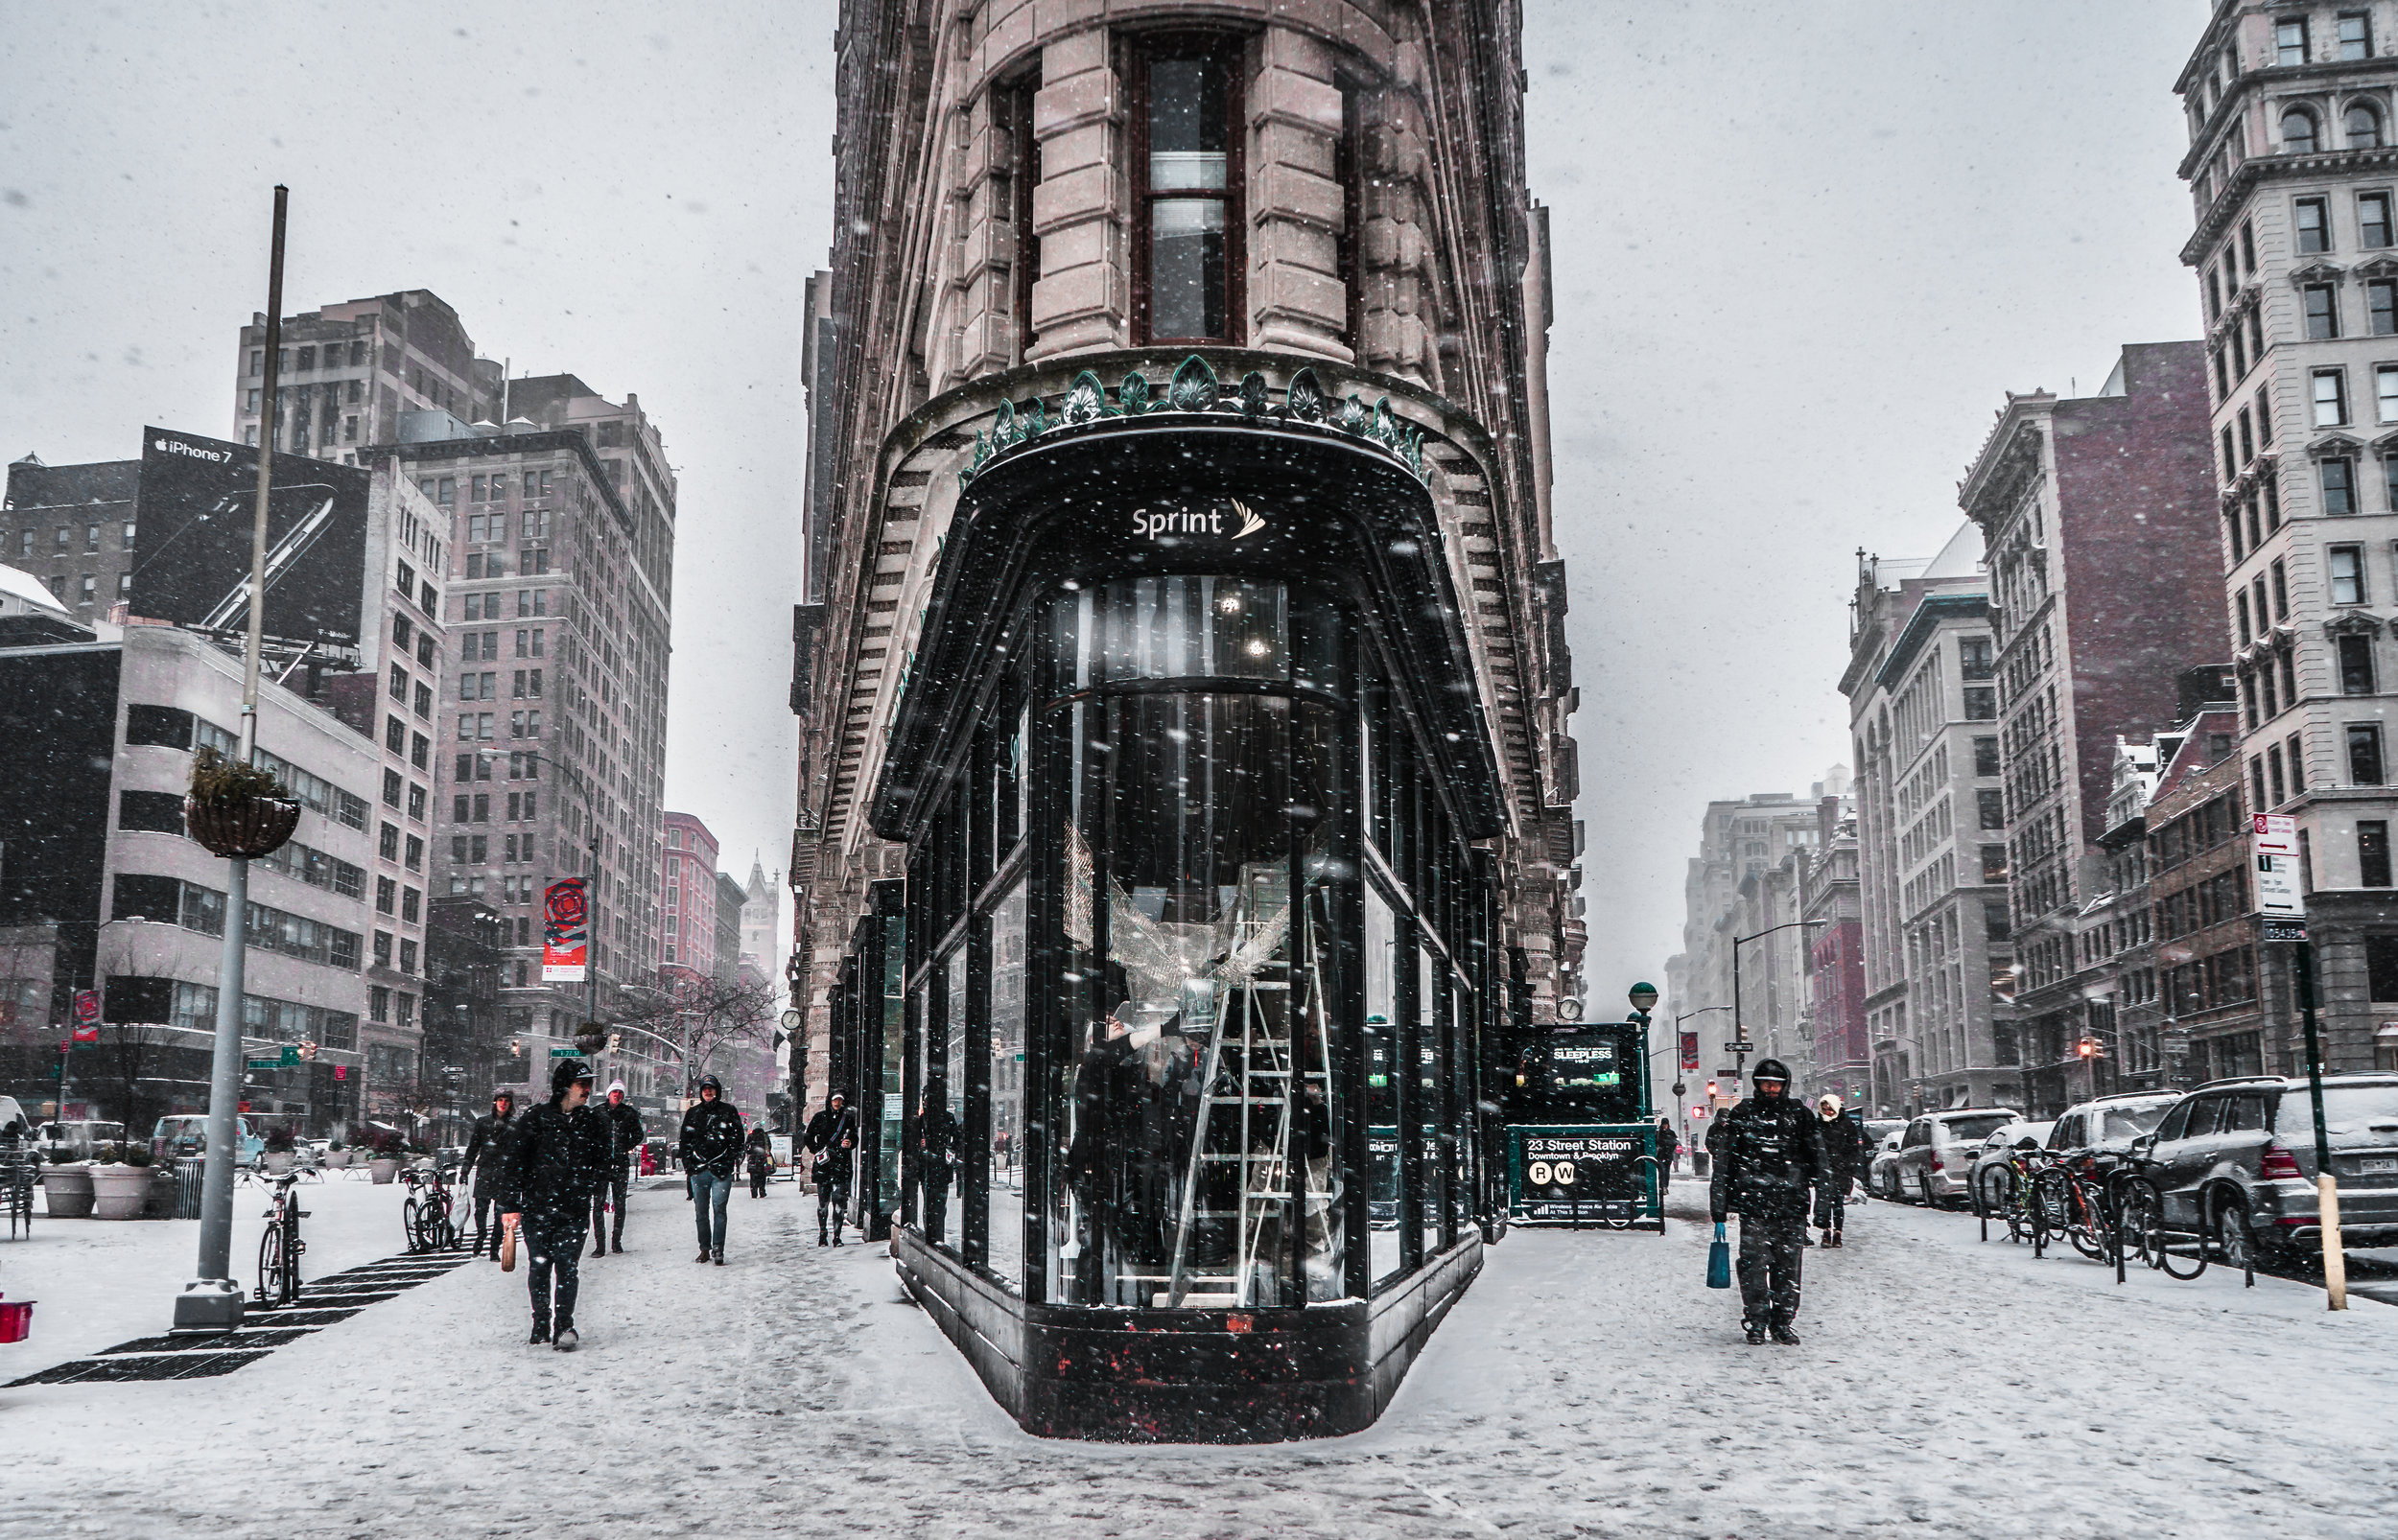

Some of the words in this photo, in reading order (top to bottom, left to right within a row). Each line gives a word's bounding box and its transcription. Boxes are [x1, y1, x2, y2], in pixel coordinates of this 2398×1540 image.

[169, 440, 221, 462] iPhone
[223, 451, 232, 463] 7
[1133, 506, 1222, 541] Sprint
[1554, 1050, 1612, 1060] SLEEPLESS
[1528, 1140, 1543, 1151] 23
[1547, 1140, 1585, 1151] Street
[1588, 1139, 1631, 1151] Station
